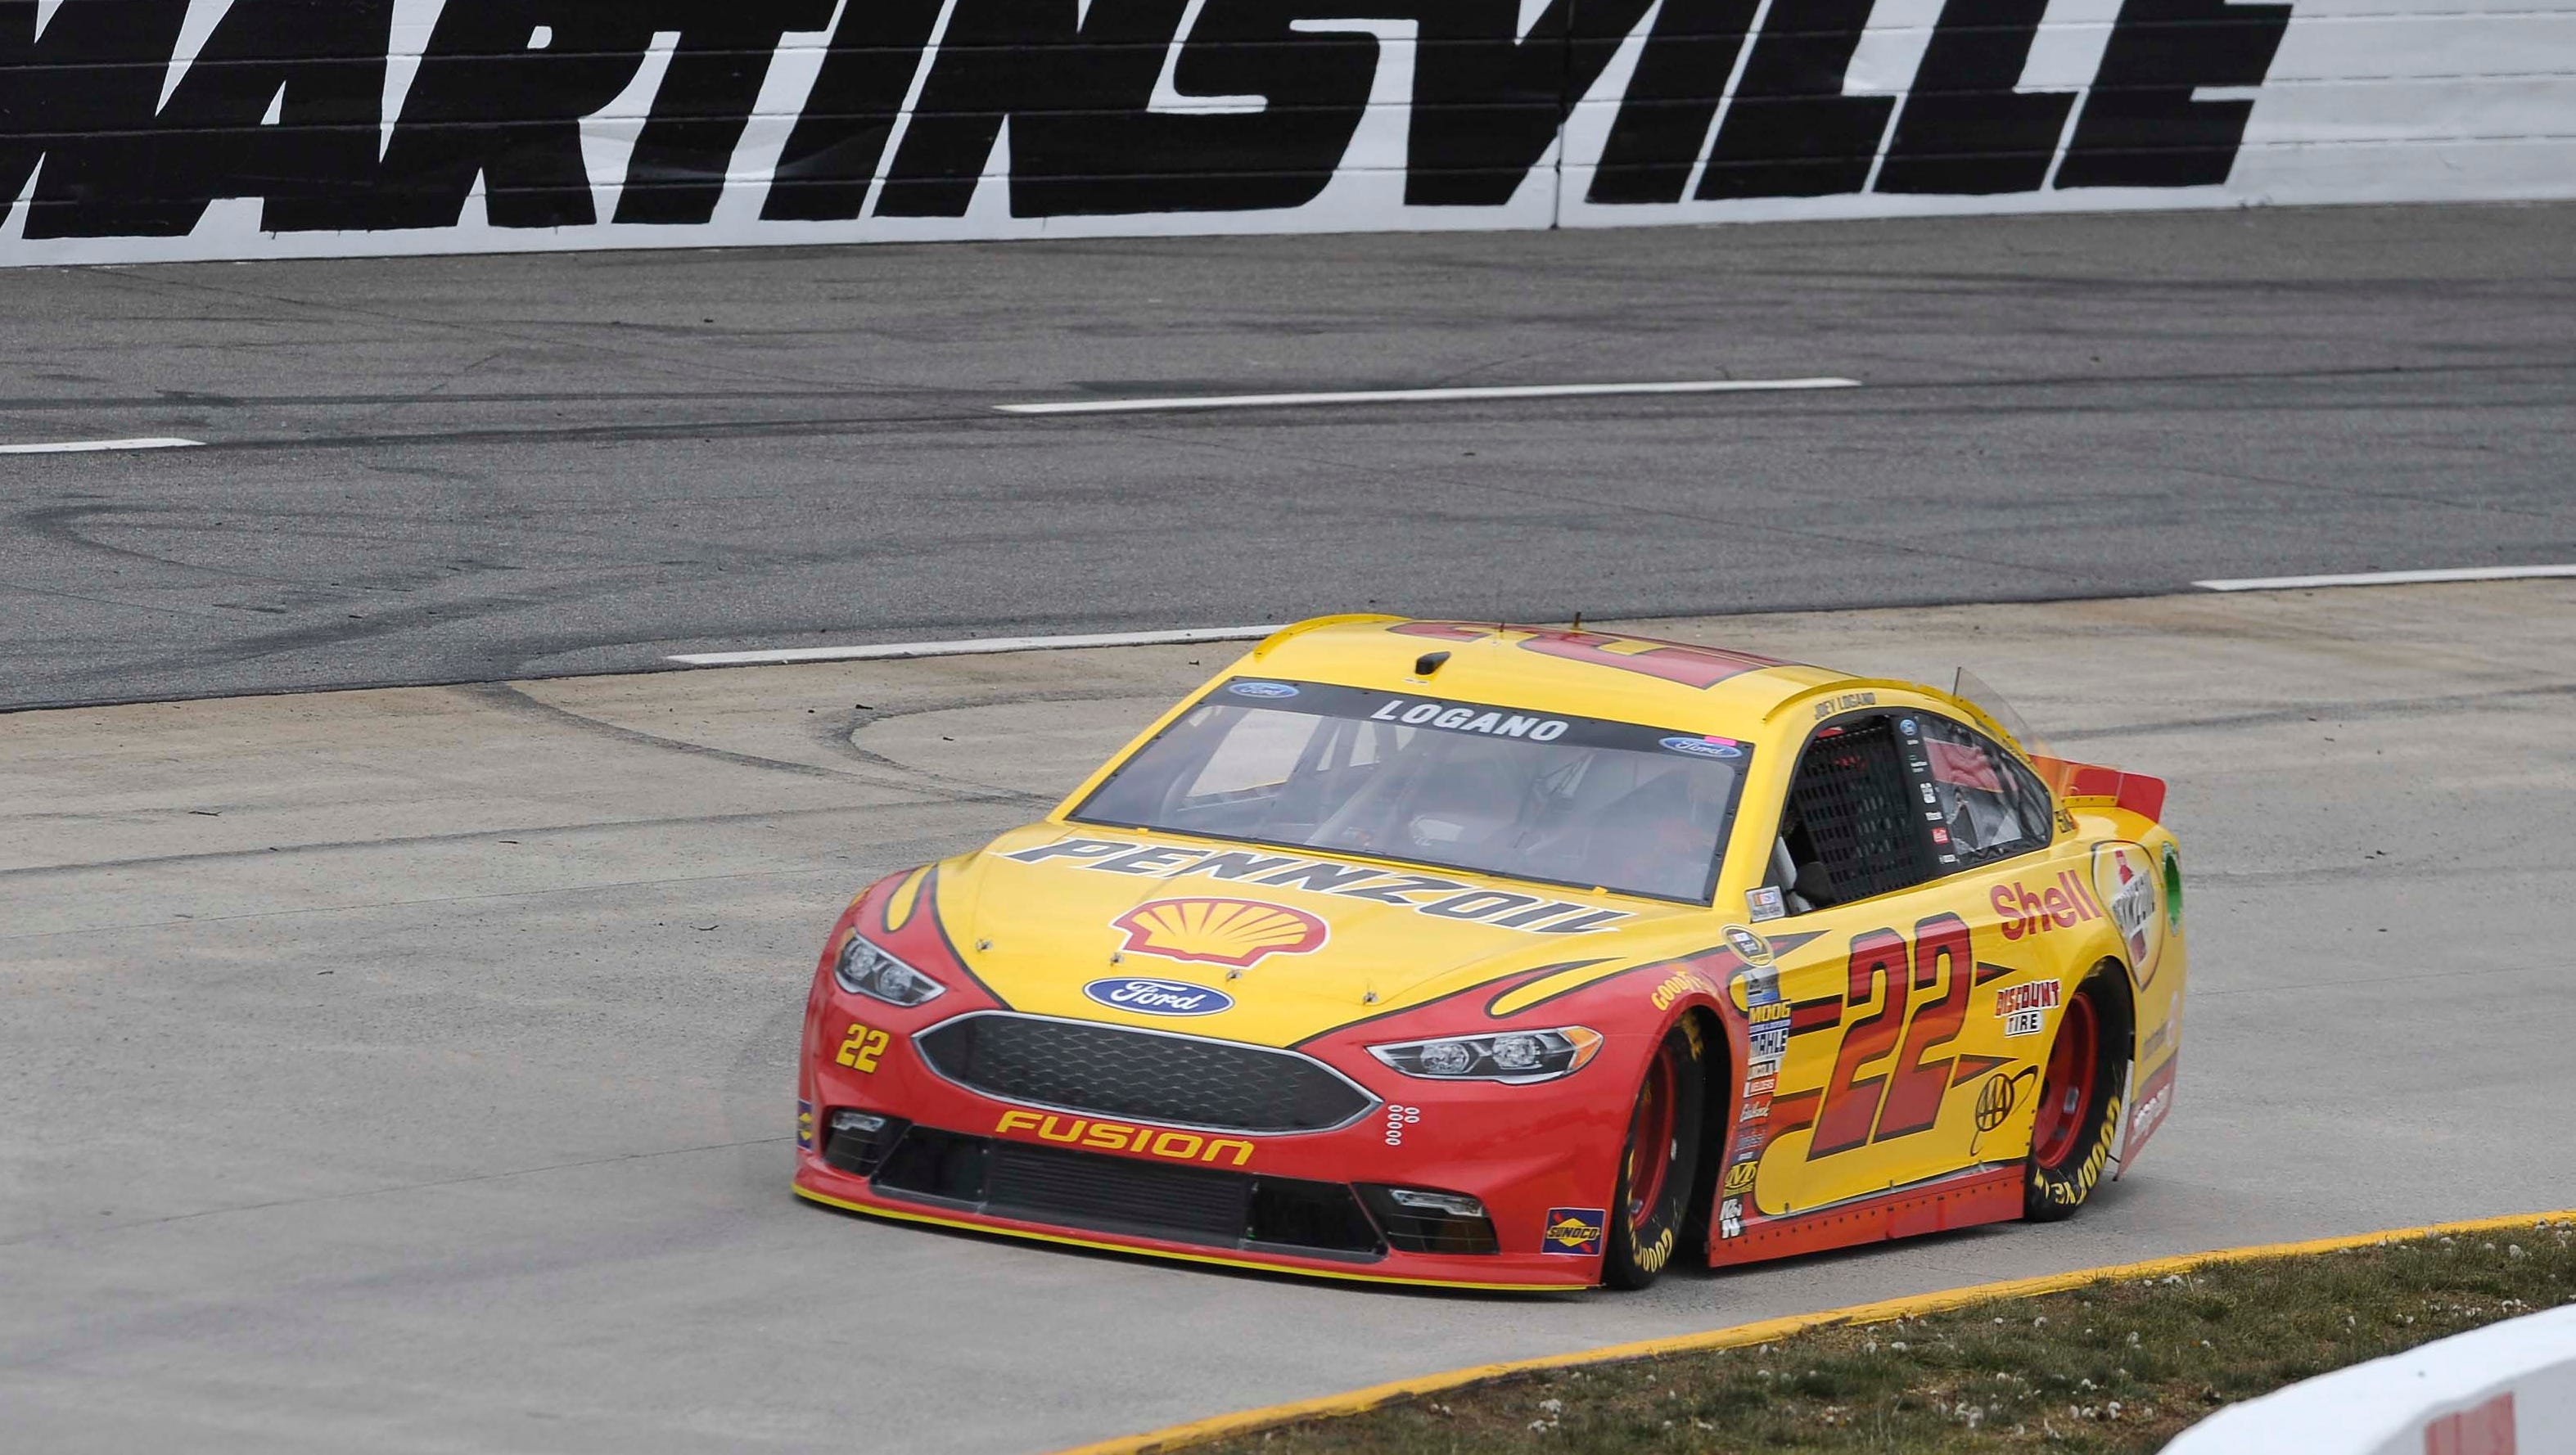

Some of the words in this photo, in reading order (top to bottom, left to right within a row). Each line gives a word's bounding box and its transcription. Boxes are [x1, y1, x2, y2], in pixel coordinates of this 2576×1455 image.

[1370, 700, 1569, 741] LOGANO
[1000, 838, 1635, 935] PENNZOIL
[1990, 869, 2103, 941] Shell
[1110, 981, 1207, 1011] Ford
[1748, 1001, 1792, 1025] MOOG
[1995, 980, 2060, 1017] DISCOUNT
[1749, 1029, 1788, 1056] MAHLE
[1806, 912, 1972, 1161] 22
[2008, 1013, 2038, 1034] TIRE
[836, 1023, 890, 1074] 22
[995, 1110, 1255, 1166] FUSION
[2033, 1095, 2122, 1206] GOODYE
[1548, 1227, 1599, 1240] SUNOCO
